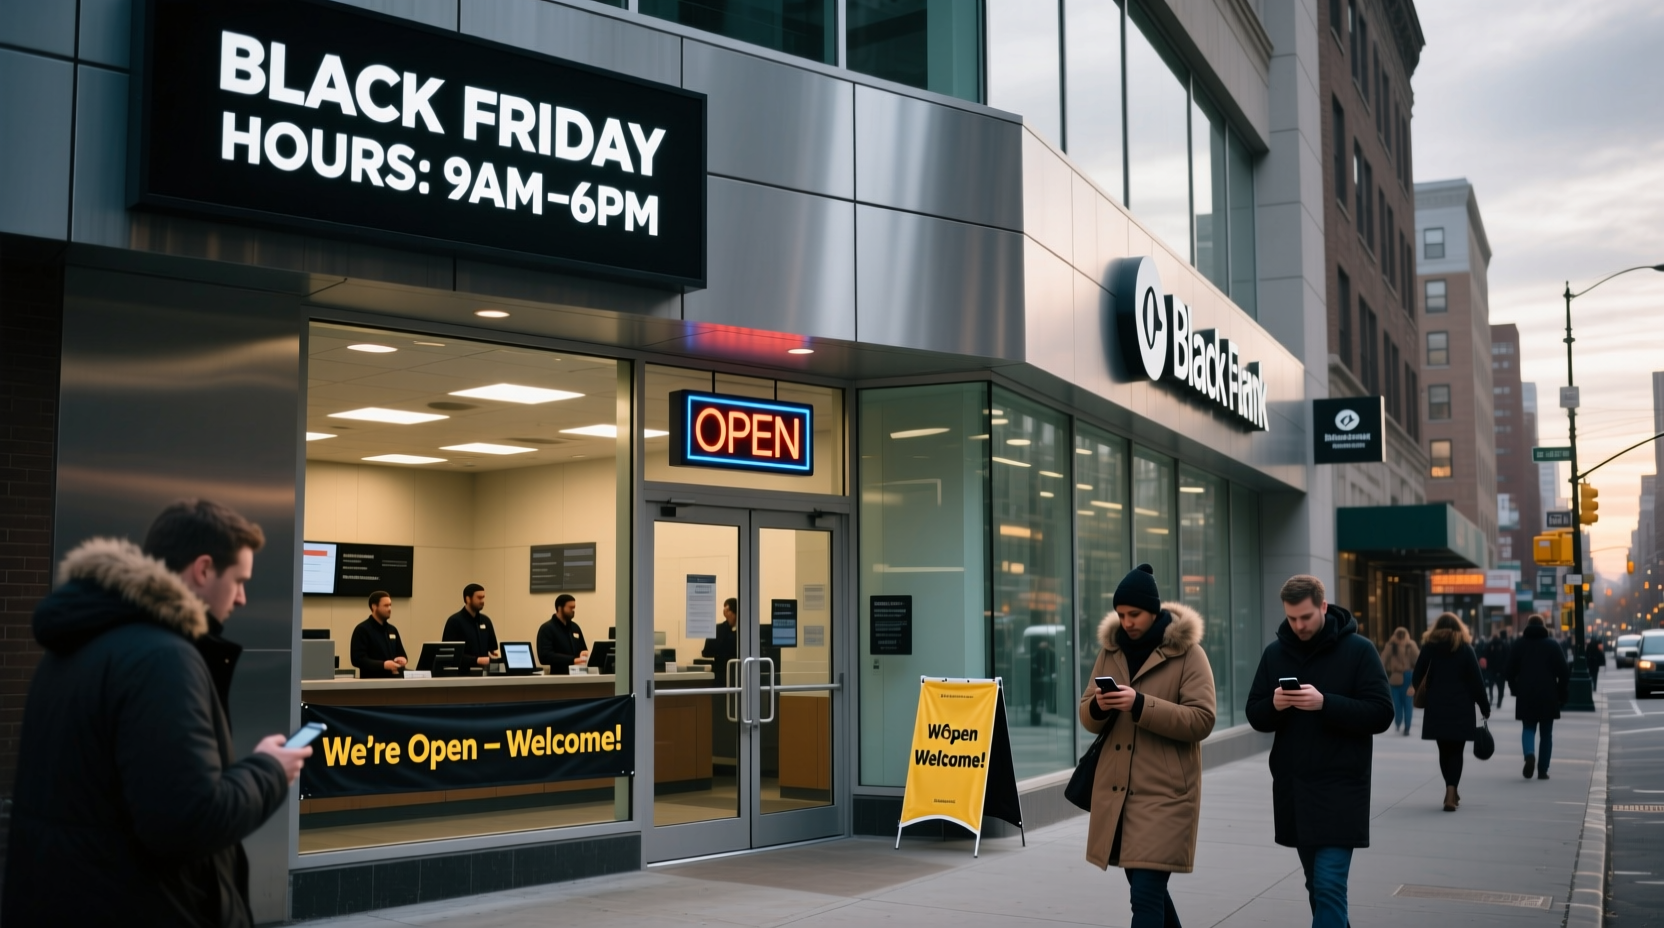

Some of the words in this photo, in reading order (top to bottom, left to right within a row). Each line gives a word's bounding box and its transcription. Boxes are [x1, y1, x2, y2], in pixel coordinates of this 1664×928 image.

[219, 30, 446, 135] BLACK
[463, 85, 666, 177] FRIDAY
[221, 111, 431, 195] HOURS:
[1172, 294, 1228, 407] Black
[695, 407, 800, 460] OPEN
[407, 733, 478, 771] Open
[505, 723, 622, 758] Welcome!
[915, 749, 986, 768] Welcome!
